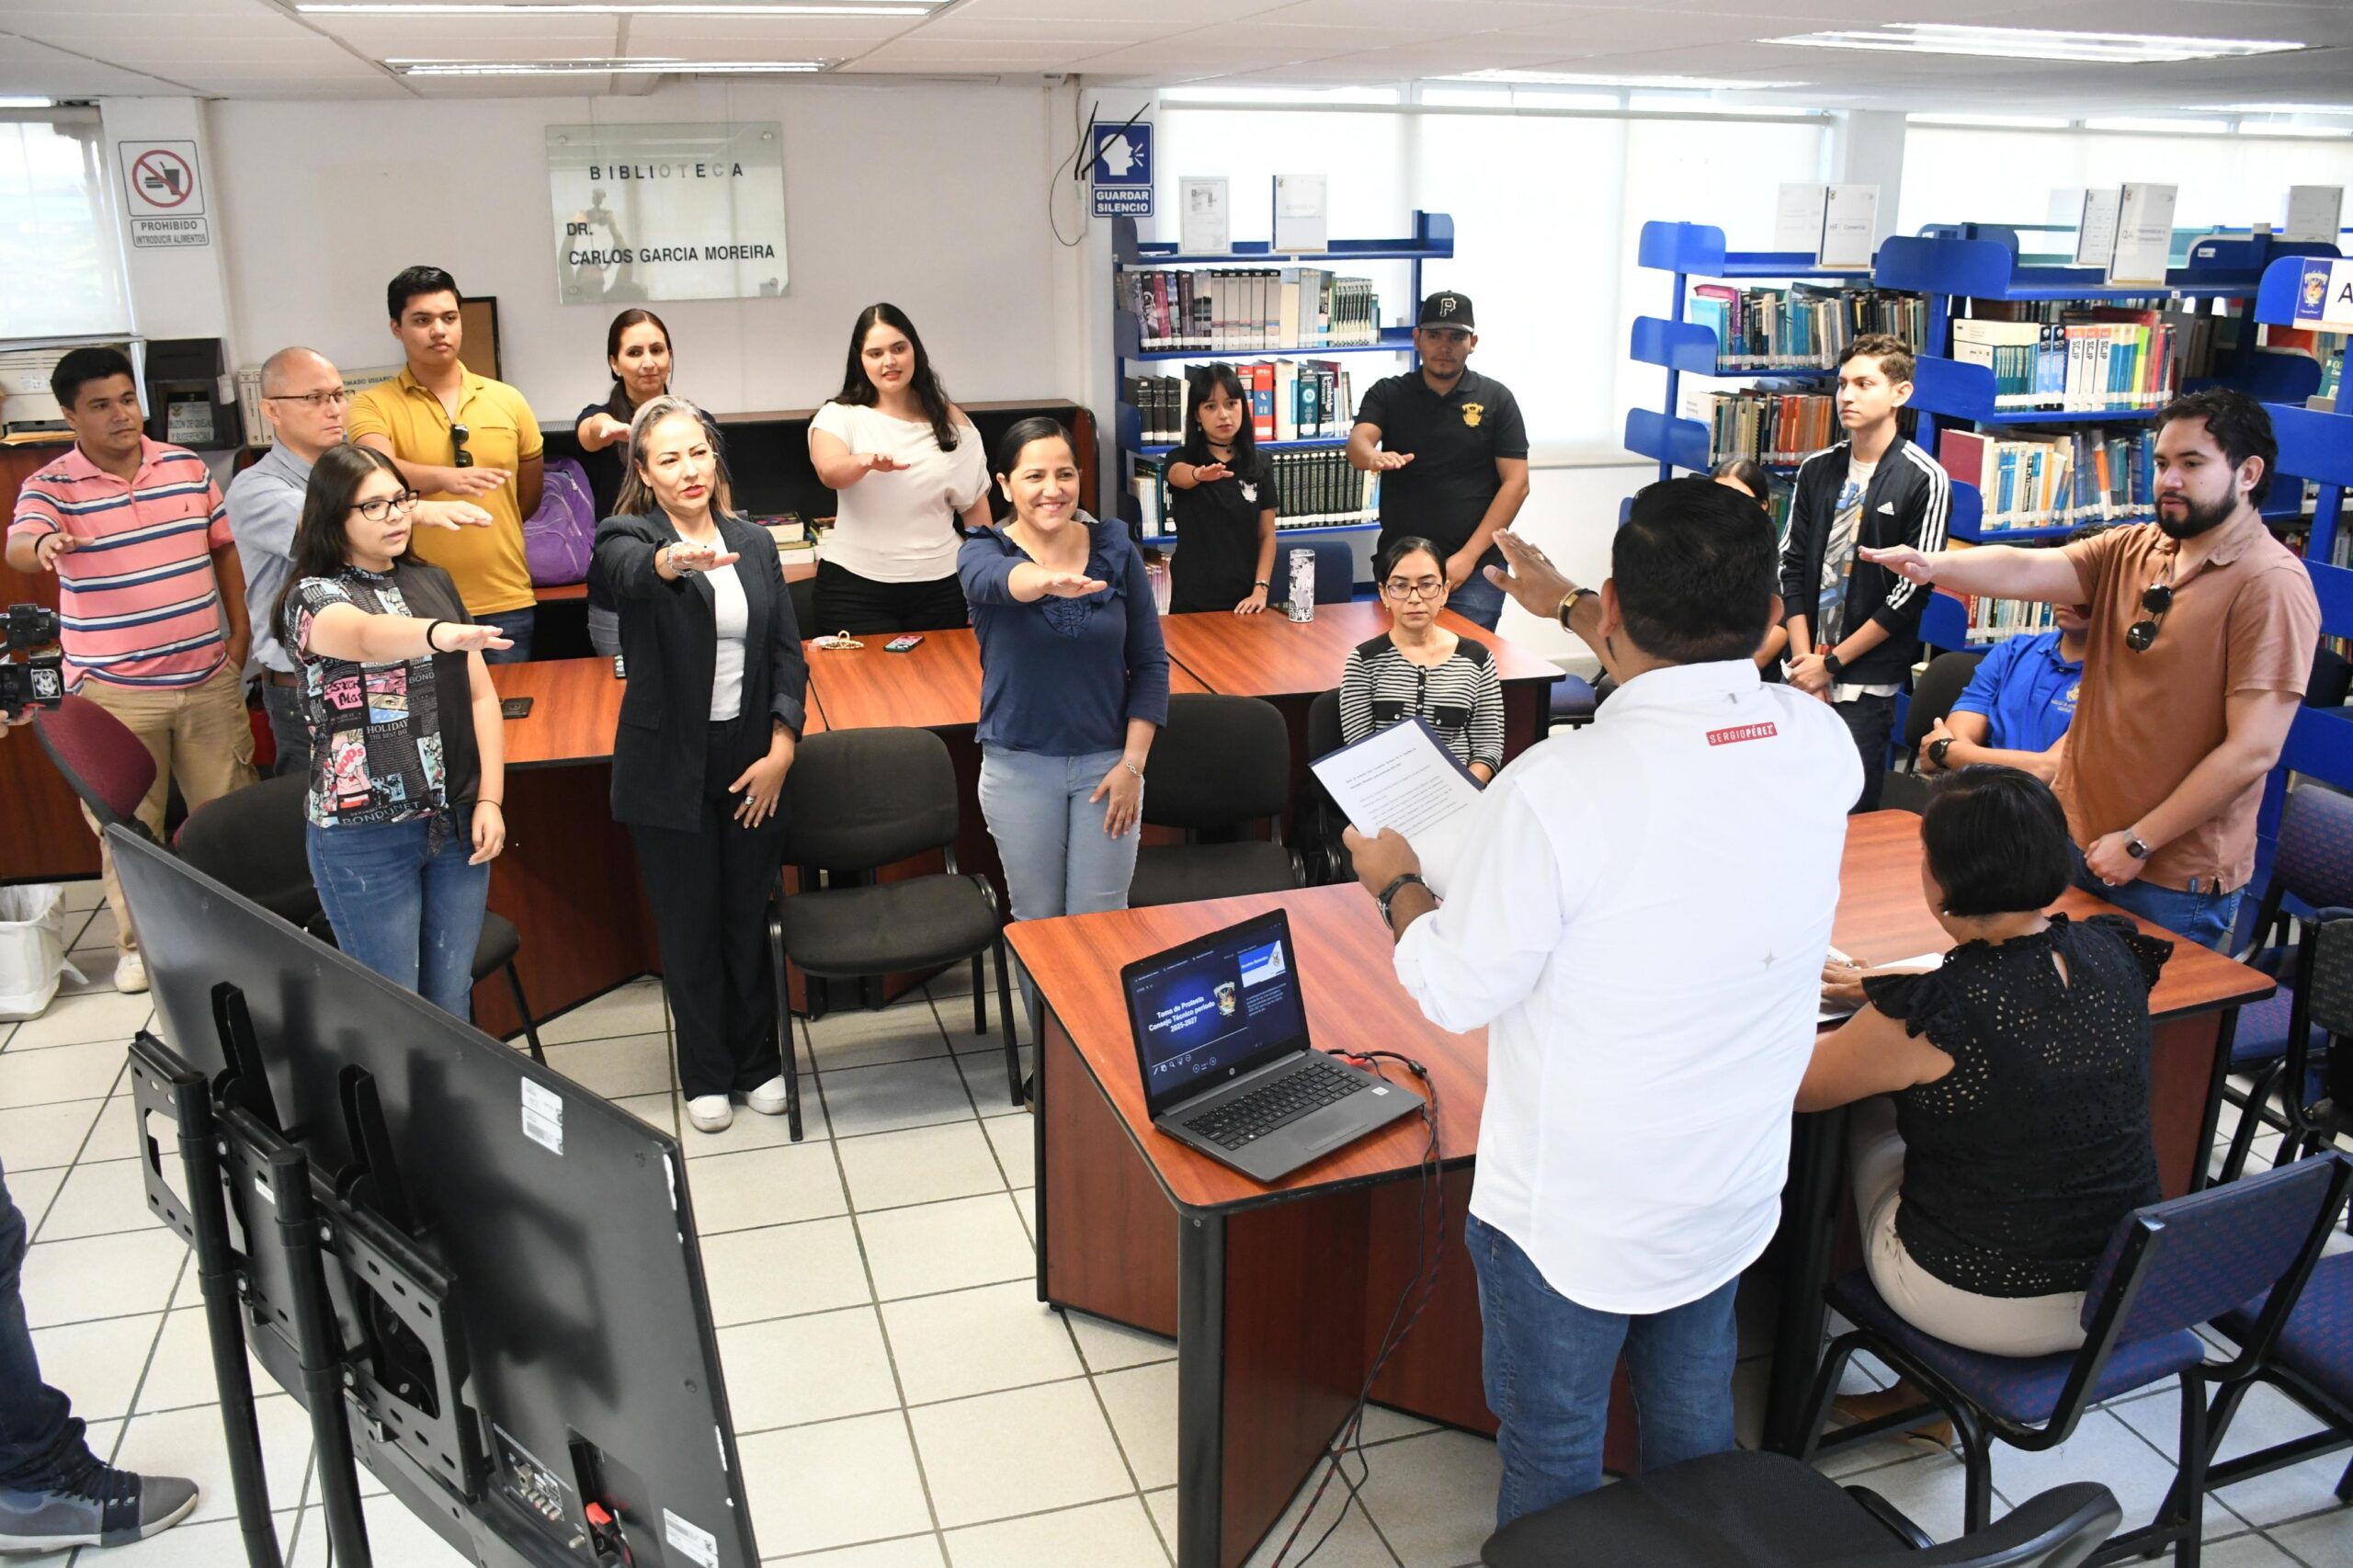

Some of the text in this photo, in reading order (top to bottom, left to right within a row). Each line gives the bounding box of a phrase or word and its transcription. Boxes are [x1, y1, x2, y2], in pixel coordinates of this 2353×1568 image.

[589, 163, 744, 181] BIBLIOTECA
[1096, 191, 1150, 201] GUARDAR
[1097, 203, 1149, 213] SILENCIO
[140, 221, 199, 232] PROHIBIDO
[566, 222, 594, 236] DR.
[135, 233, 207, 245] INTRODUCIR ALIMENTOS
[568, 244, 776, 266] CARLOS GARCIA MOREIRA
[1439, 297, 1457, 317] P
[367, 719, 409, 734] HOLIDAY
[1156, 996, 1205, 1018] Toma de Protesta
[1148, 1018, 1173, 1032] Consejo
[1172, 1010, 1195, 1022] Técnico
